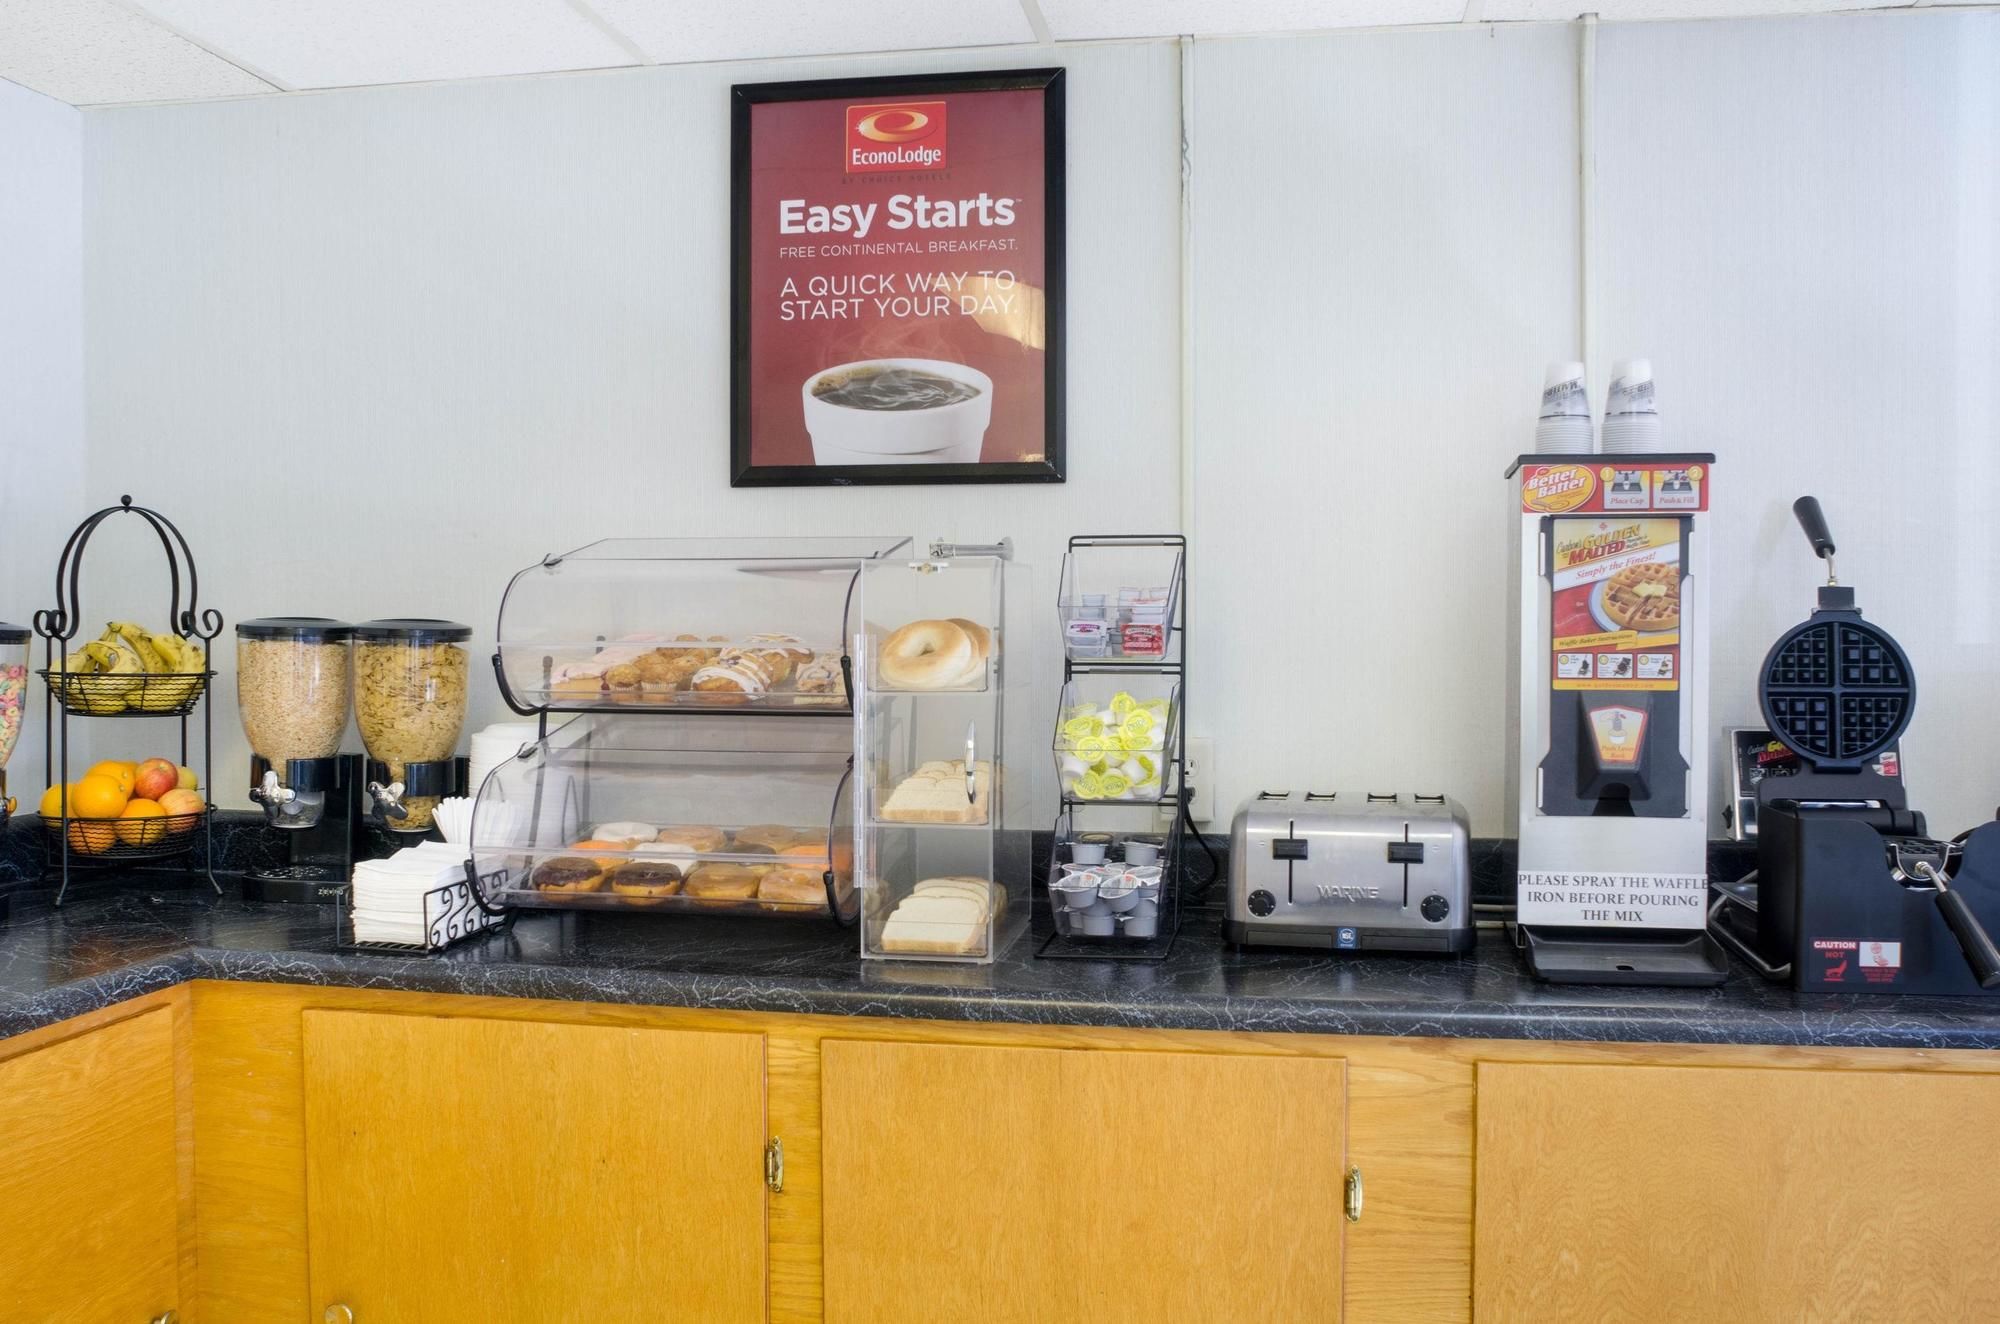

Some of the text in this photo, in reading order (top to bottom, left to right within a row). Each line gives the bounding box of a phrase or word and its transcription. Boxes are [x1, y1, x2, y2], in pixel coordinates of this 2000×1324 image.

[852, 146, 941, 166] EconoLodge
[780, 199, 877, 238] Easy
[780, 238, 1018, 259] FREE CONTINENTAL BREAKFAST.
[780, 270, 1016, 297] A QUICK WAY TO
[780, 295, 1018, 321] START YOUR DAY.
[1528, 469, 1578, 490] Better
[1537, 477, 1586, 499] Batter
[1582, 523, 1640, 549] GOLDEN
[1568, 540, 1626, 565] MALTED
[1576, 551, 1657, 579] Simply the Finest!
[1519, 874, 1708, 890] PLEASE SPRAY THE WAFFLE
[1316, 884, 1379, 902] WARING
[1527, 891, 1699, 906] IRON BEFORE POURING
[1580, 910, 1644, 922] THE MIX
[1814, 941, 1856, 949] CAUTION
